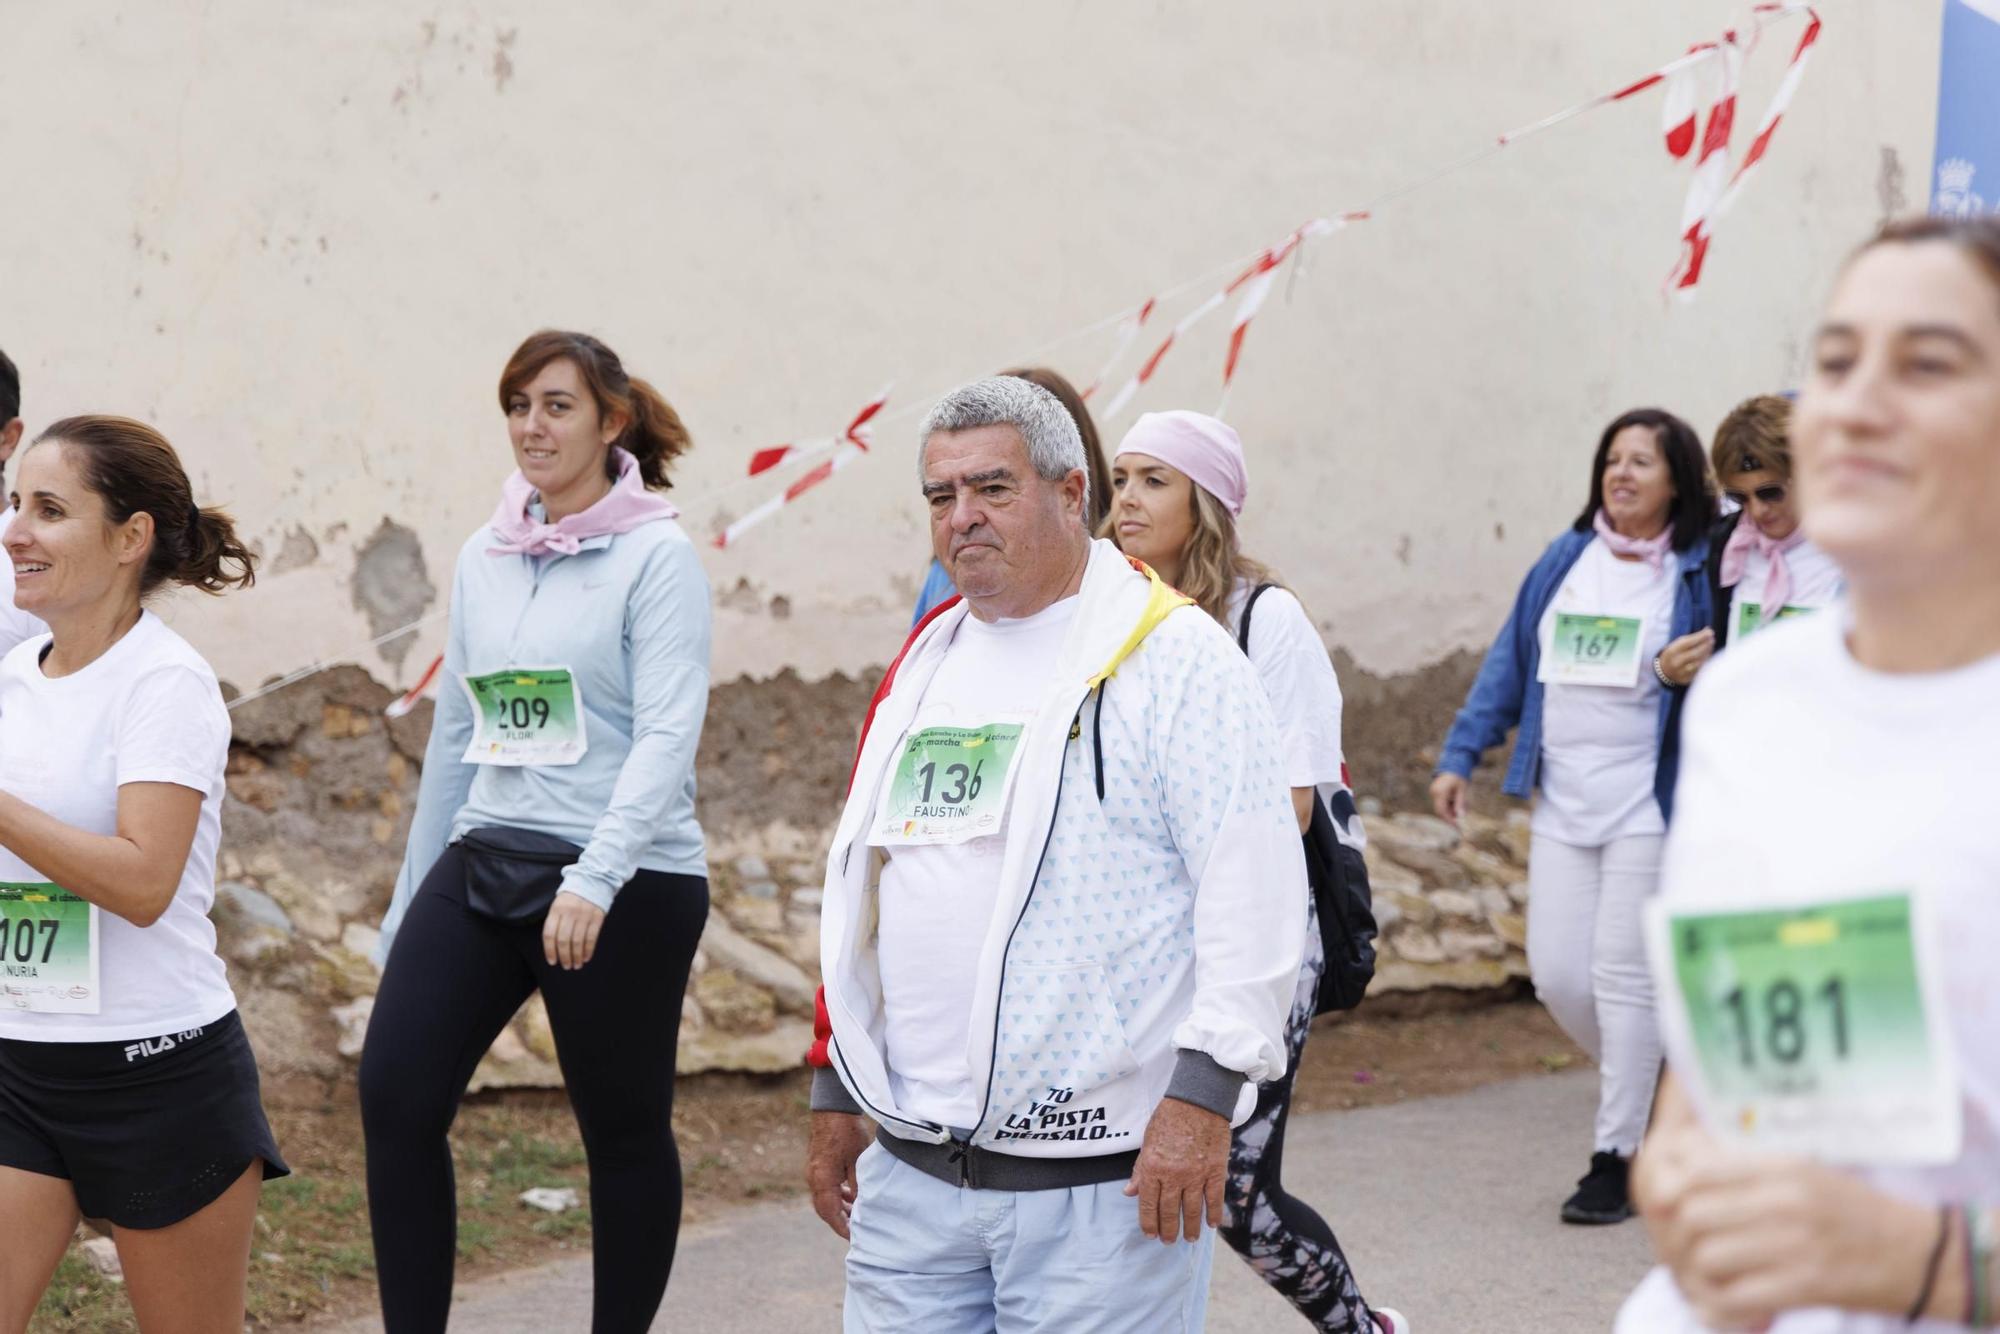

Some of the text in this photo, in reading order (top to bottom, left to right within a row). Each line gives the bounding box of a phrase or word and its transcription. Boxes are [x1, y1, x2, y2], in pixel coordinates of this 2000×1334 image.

[1574, 633, 1619, 656] 167
[926, 737, 960, 747] marcha
[919, 759, 985, 804] 136
[0, 918, 60, 964] 107
[6, 965, 39, 978] NURIA
[1722, 975, 1848, 1068] 181
[124, 1035, 176, 1062] FILA
[1046, 1087, 1074, 1104] TÚ
[1004, 1107, 1106, 1130] LA PISTA
